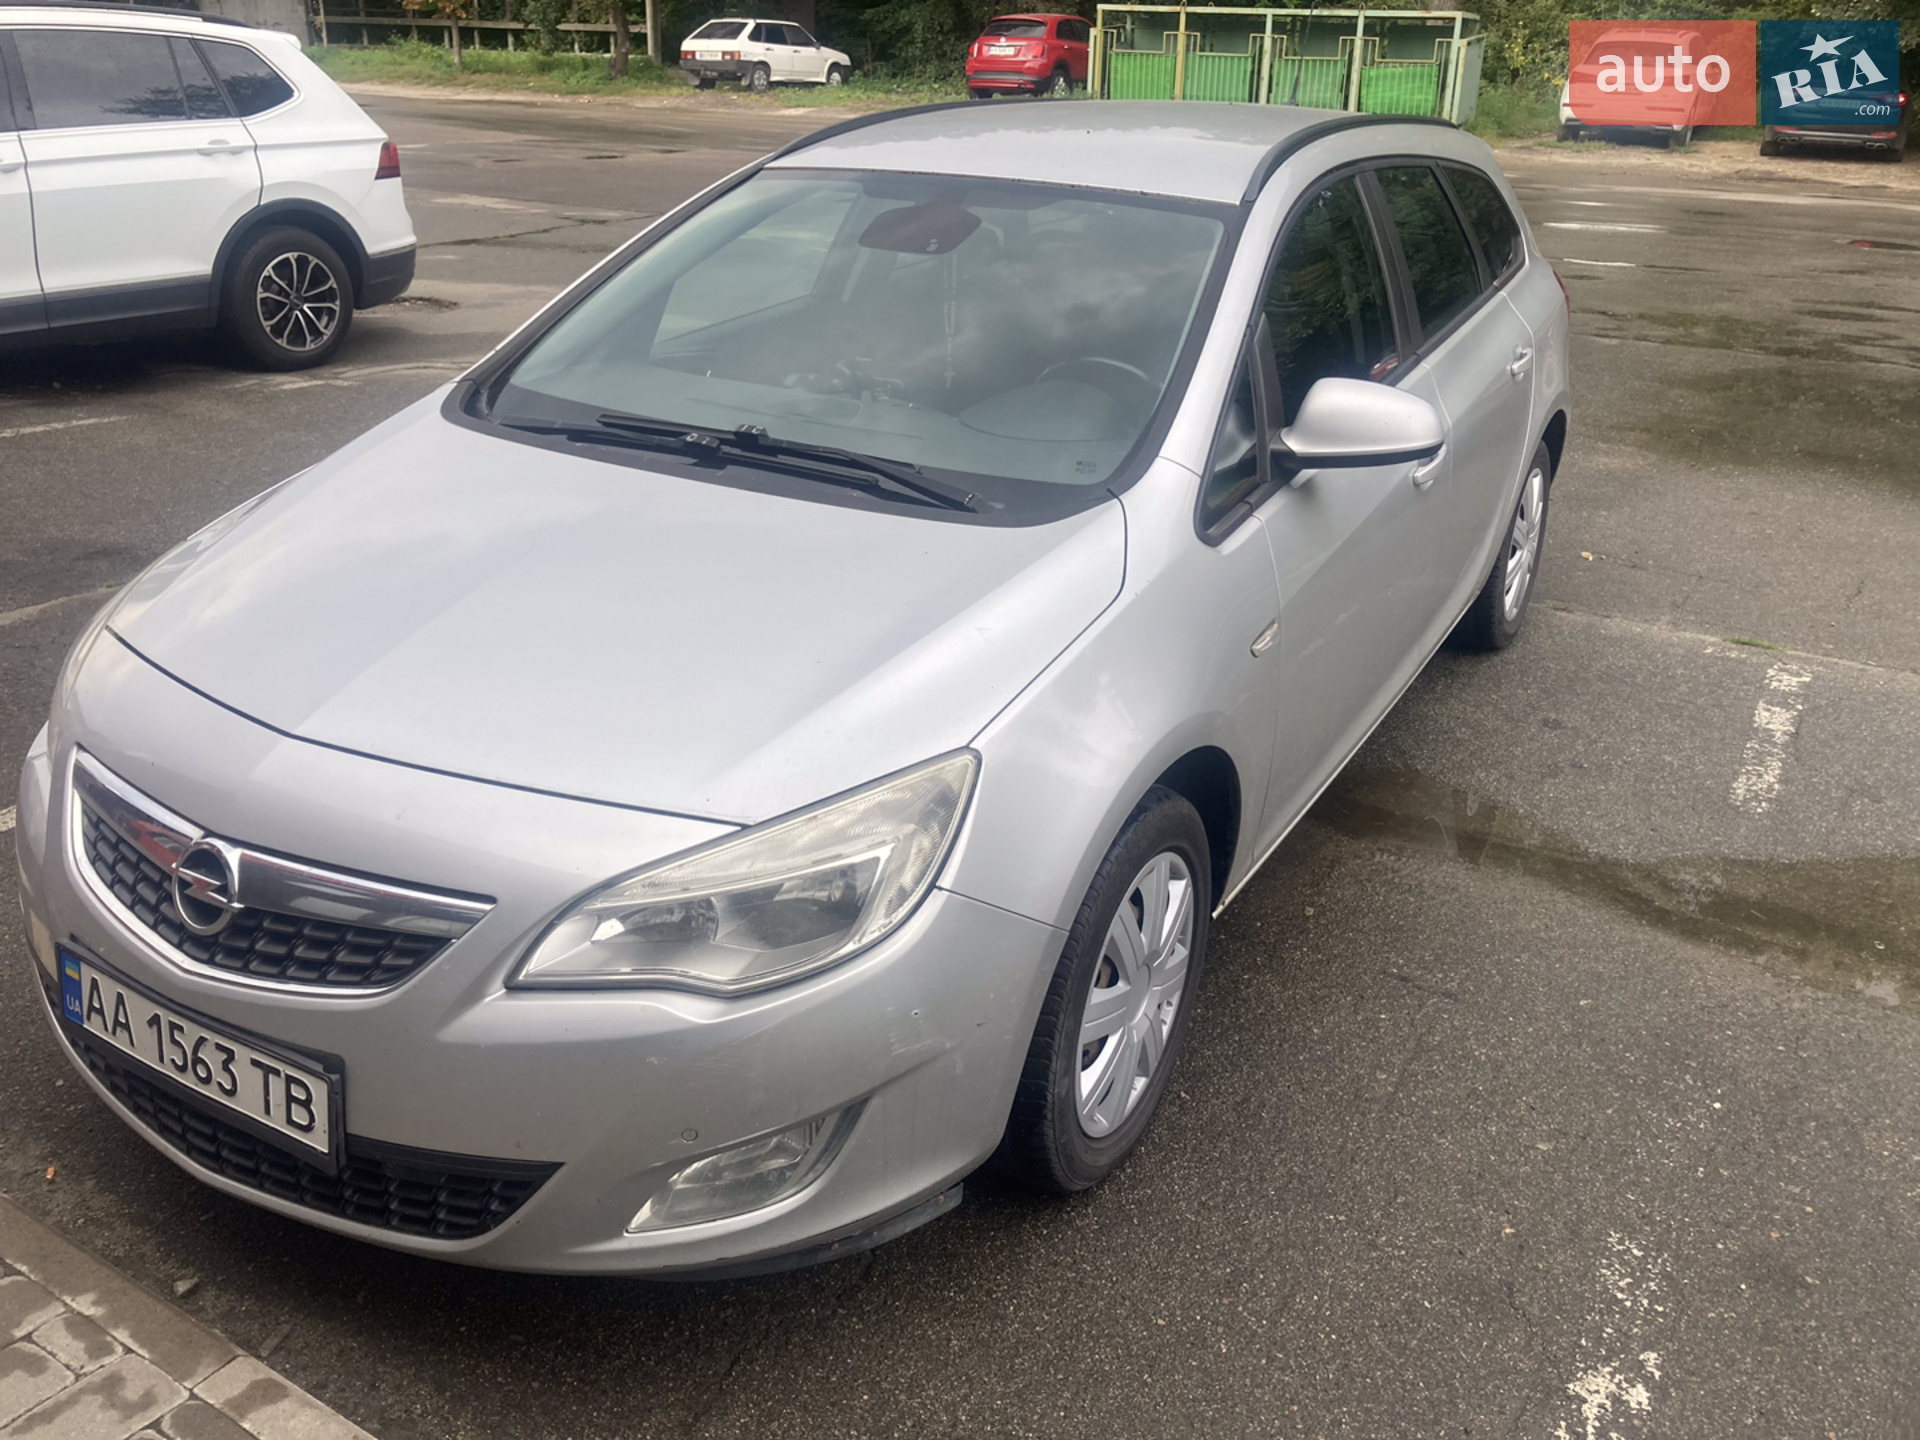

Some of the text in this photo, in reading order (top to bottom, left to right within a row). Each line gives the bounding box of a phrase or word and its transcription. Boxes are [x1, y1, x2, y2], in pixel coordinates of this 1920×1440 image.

[66, 994, 81, 1016] UA
[86, 976, 316, 1133] AA 1563 TB
